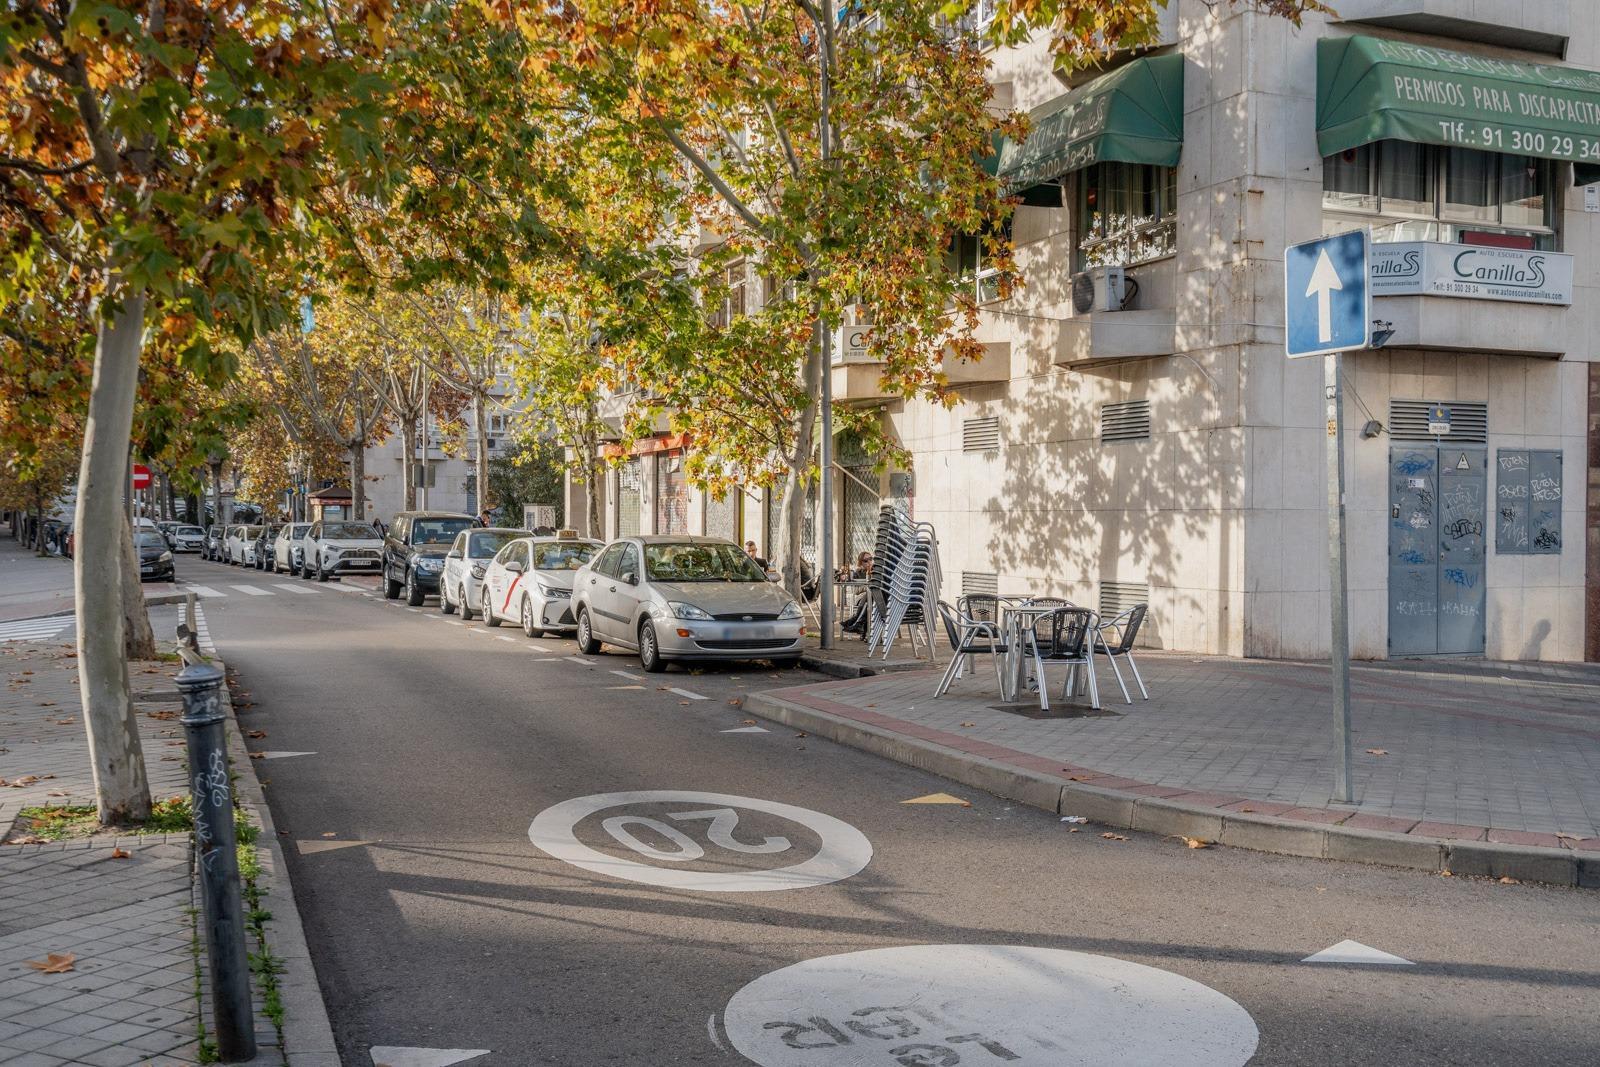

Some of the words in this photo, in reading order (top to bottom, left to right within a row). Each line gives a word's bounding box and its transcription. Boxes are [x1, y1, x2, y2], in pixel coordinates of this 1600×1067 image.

[1378, 42, 1438, 66] AUTO
[1439, 50, 1534, 80] ESCUELA
[1394, 76, 1466, 107] PERMISOS
[1473, 86, 1513, 113] PARA
[1439, 121, 1476, 144] Tlf.:
[1482, 127, 1503, 148] 91
[1511, 130, 1545, 153] 300
[1551, 136, 1573, 156] 29
[1579, 140, 1600, 159] 34
[1453, 250, 1545, 288] CanillaS
[1498, 251, 1524, 259] ESCUELA
[601, 808, 792, 861] 20
